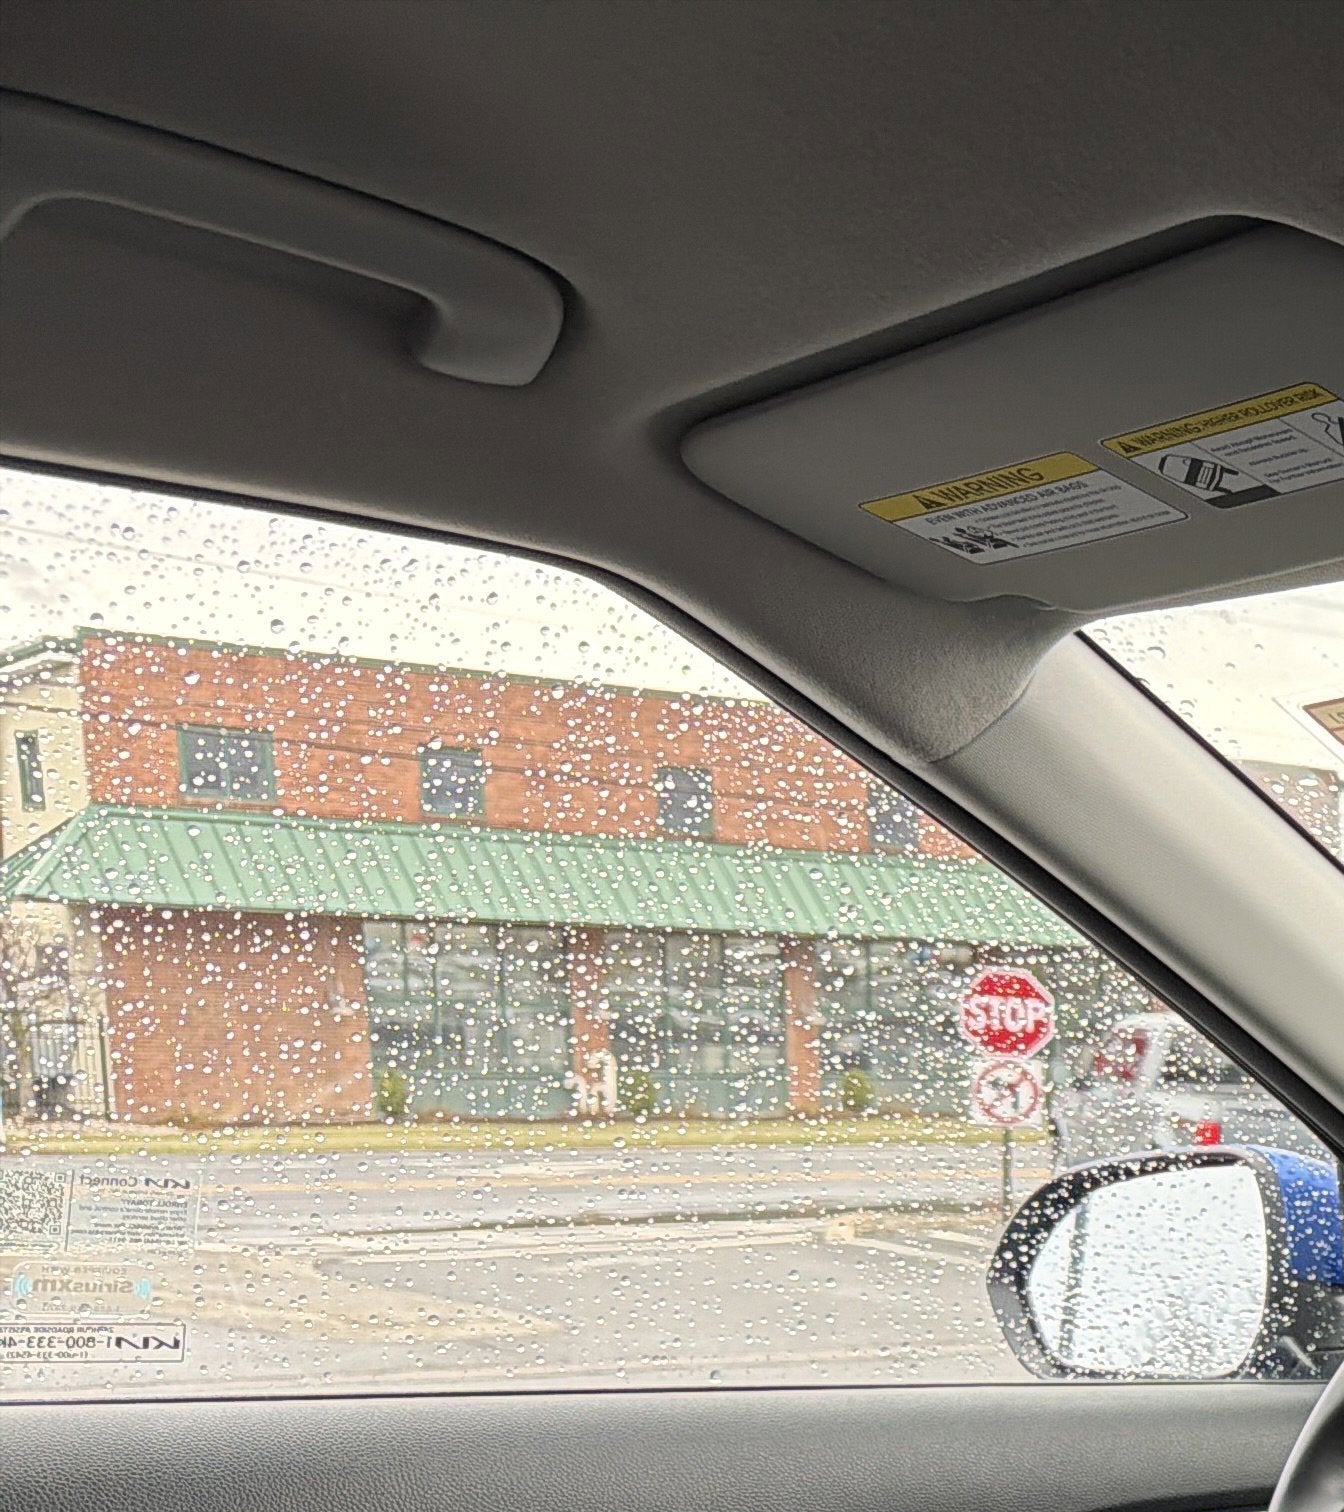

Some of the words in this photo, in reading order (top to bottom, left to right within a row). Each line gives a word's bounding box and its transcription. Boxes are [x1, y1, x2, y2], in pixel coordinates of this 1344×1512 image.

[934, 467, 1045, 504] WARNING
[926, 514, 952, 525] EVEN
[981, 494, 1038, 513] ADVANCED
[963, 997, 1049, 1034] STOP
